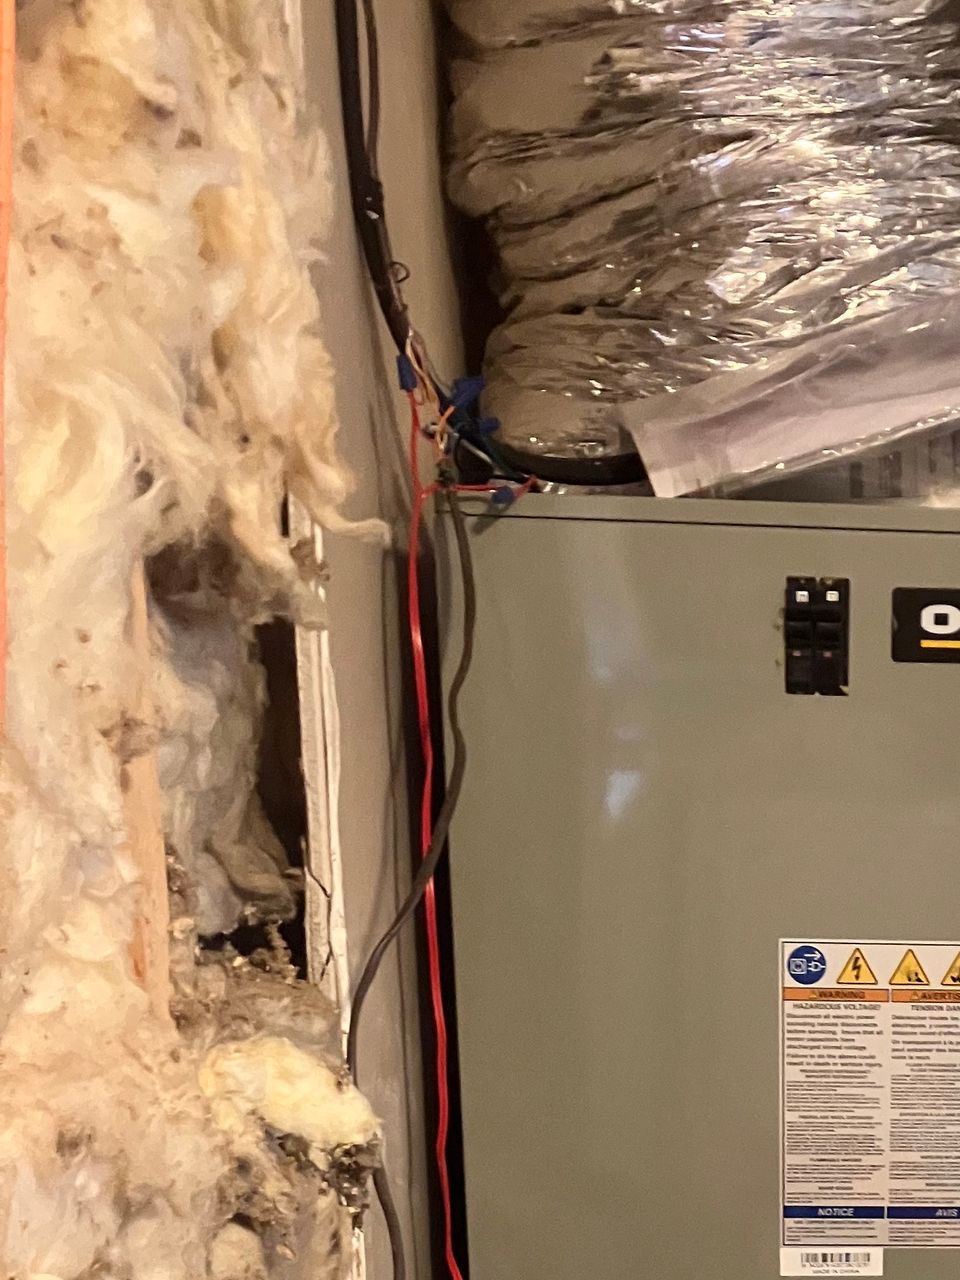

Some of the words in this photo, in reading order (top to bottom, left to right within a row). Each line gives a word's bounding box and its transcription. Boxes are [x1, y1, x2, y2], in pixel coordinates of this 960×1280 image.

[818, 990, 866, 999] WARNING
[817, 1208, 854, 1217] NOTICE
[935, 1208, 958, 1217] AVIS
